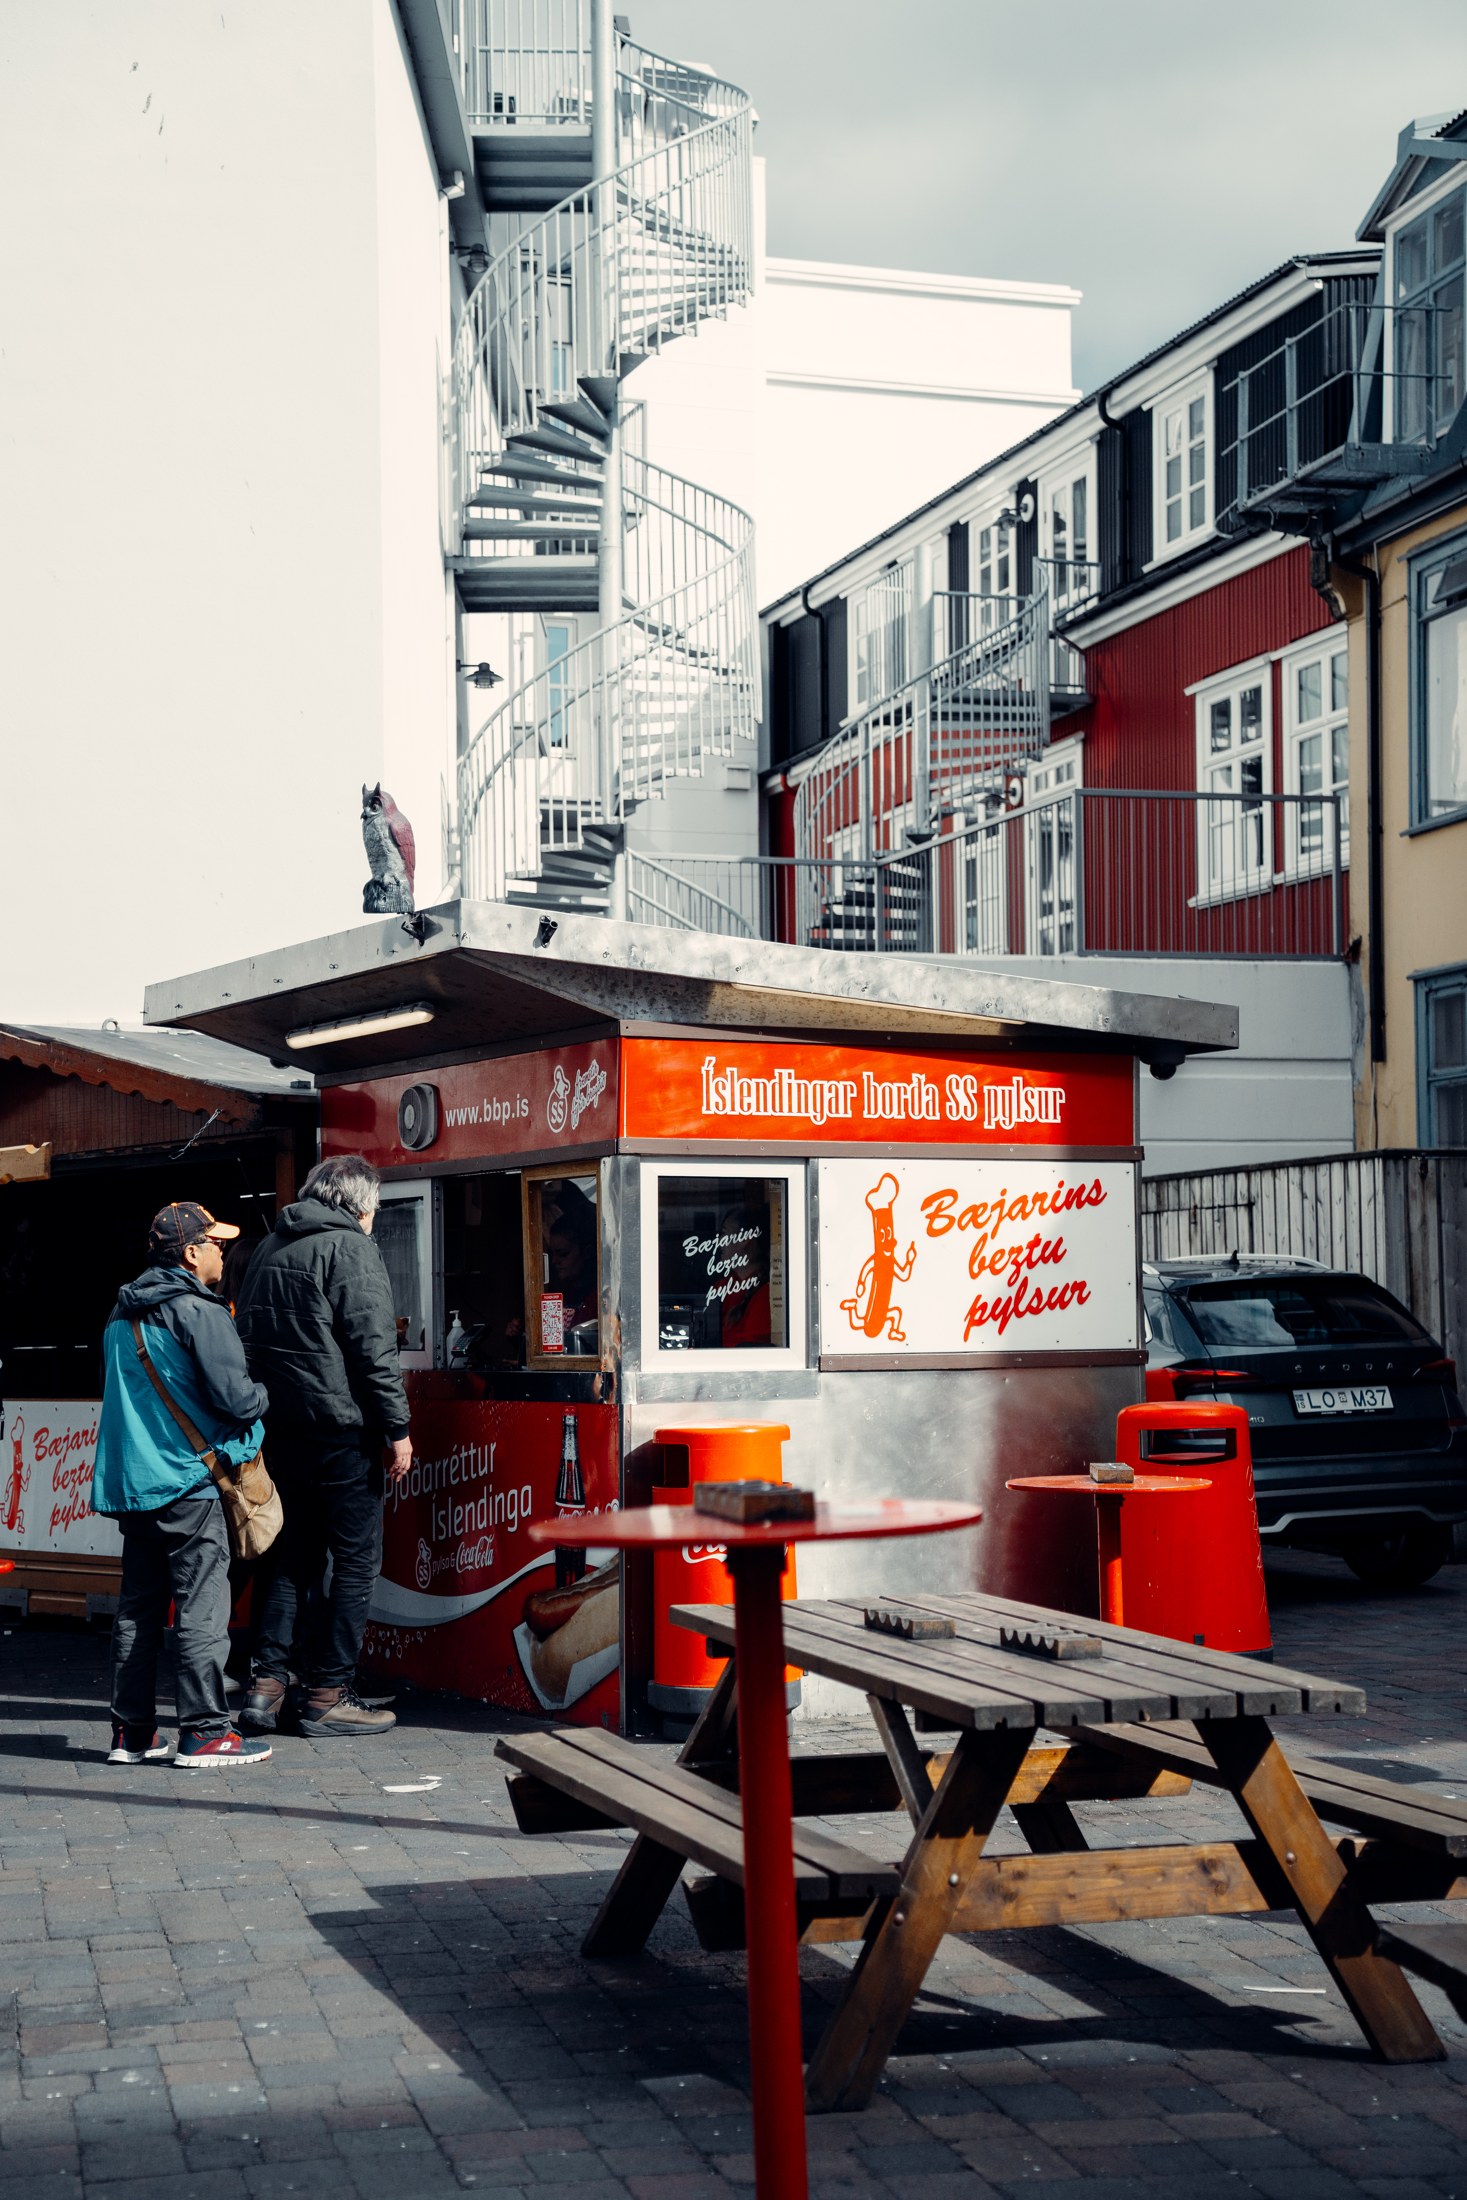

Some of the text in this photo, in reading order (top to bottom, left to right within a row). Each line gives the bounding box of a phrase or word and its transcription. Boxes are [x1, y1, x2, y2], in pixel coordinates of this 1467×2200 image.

[445, 1094, 529, 1127] www.bbp.is
[551, 1100, 564, 1124] SS
[702, 1056, 1066, 1130] Íslendingar borða SS pylsur
[920, 1177, 1108, 1239] Bæjarins
[682, 1226, 762, 1257] Bæjarins
[968, 1233, 1068, 1287] beztu
[707, 1253, 749, 1277] beztu
[705, 1277, 760, 1307] pylsur
[964, 1276, 1091, 1342] pylsur
[1351, 1389, 1386, 1407] M37
[33, 1421, 98, 1461] Bæjari
[432, 1484, 532, 1542] Íslendinga
[456, 1535, 494, 1574] Coca-Cola
